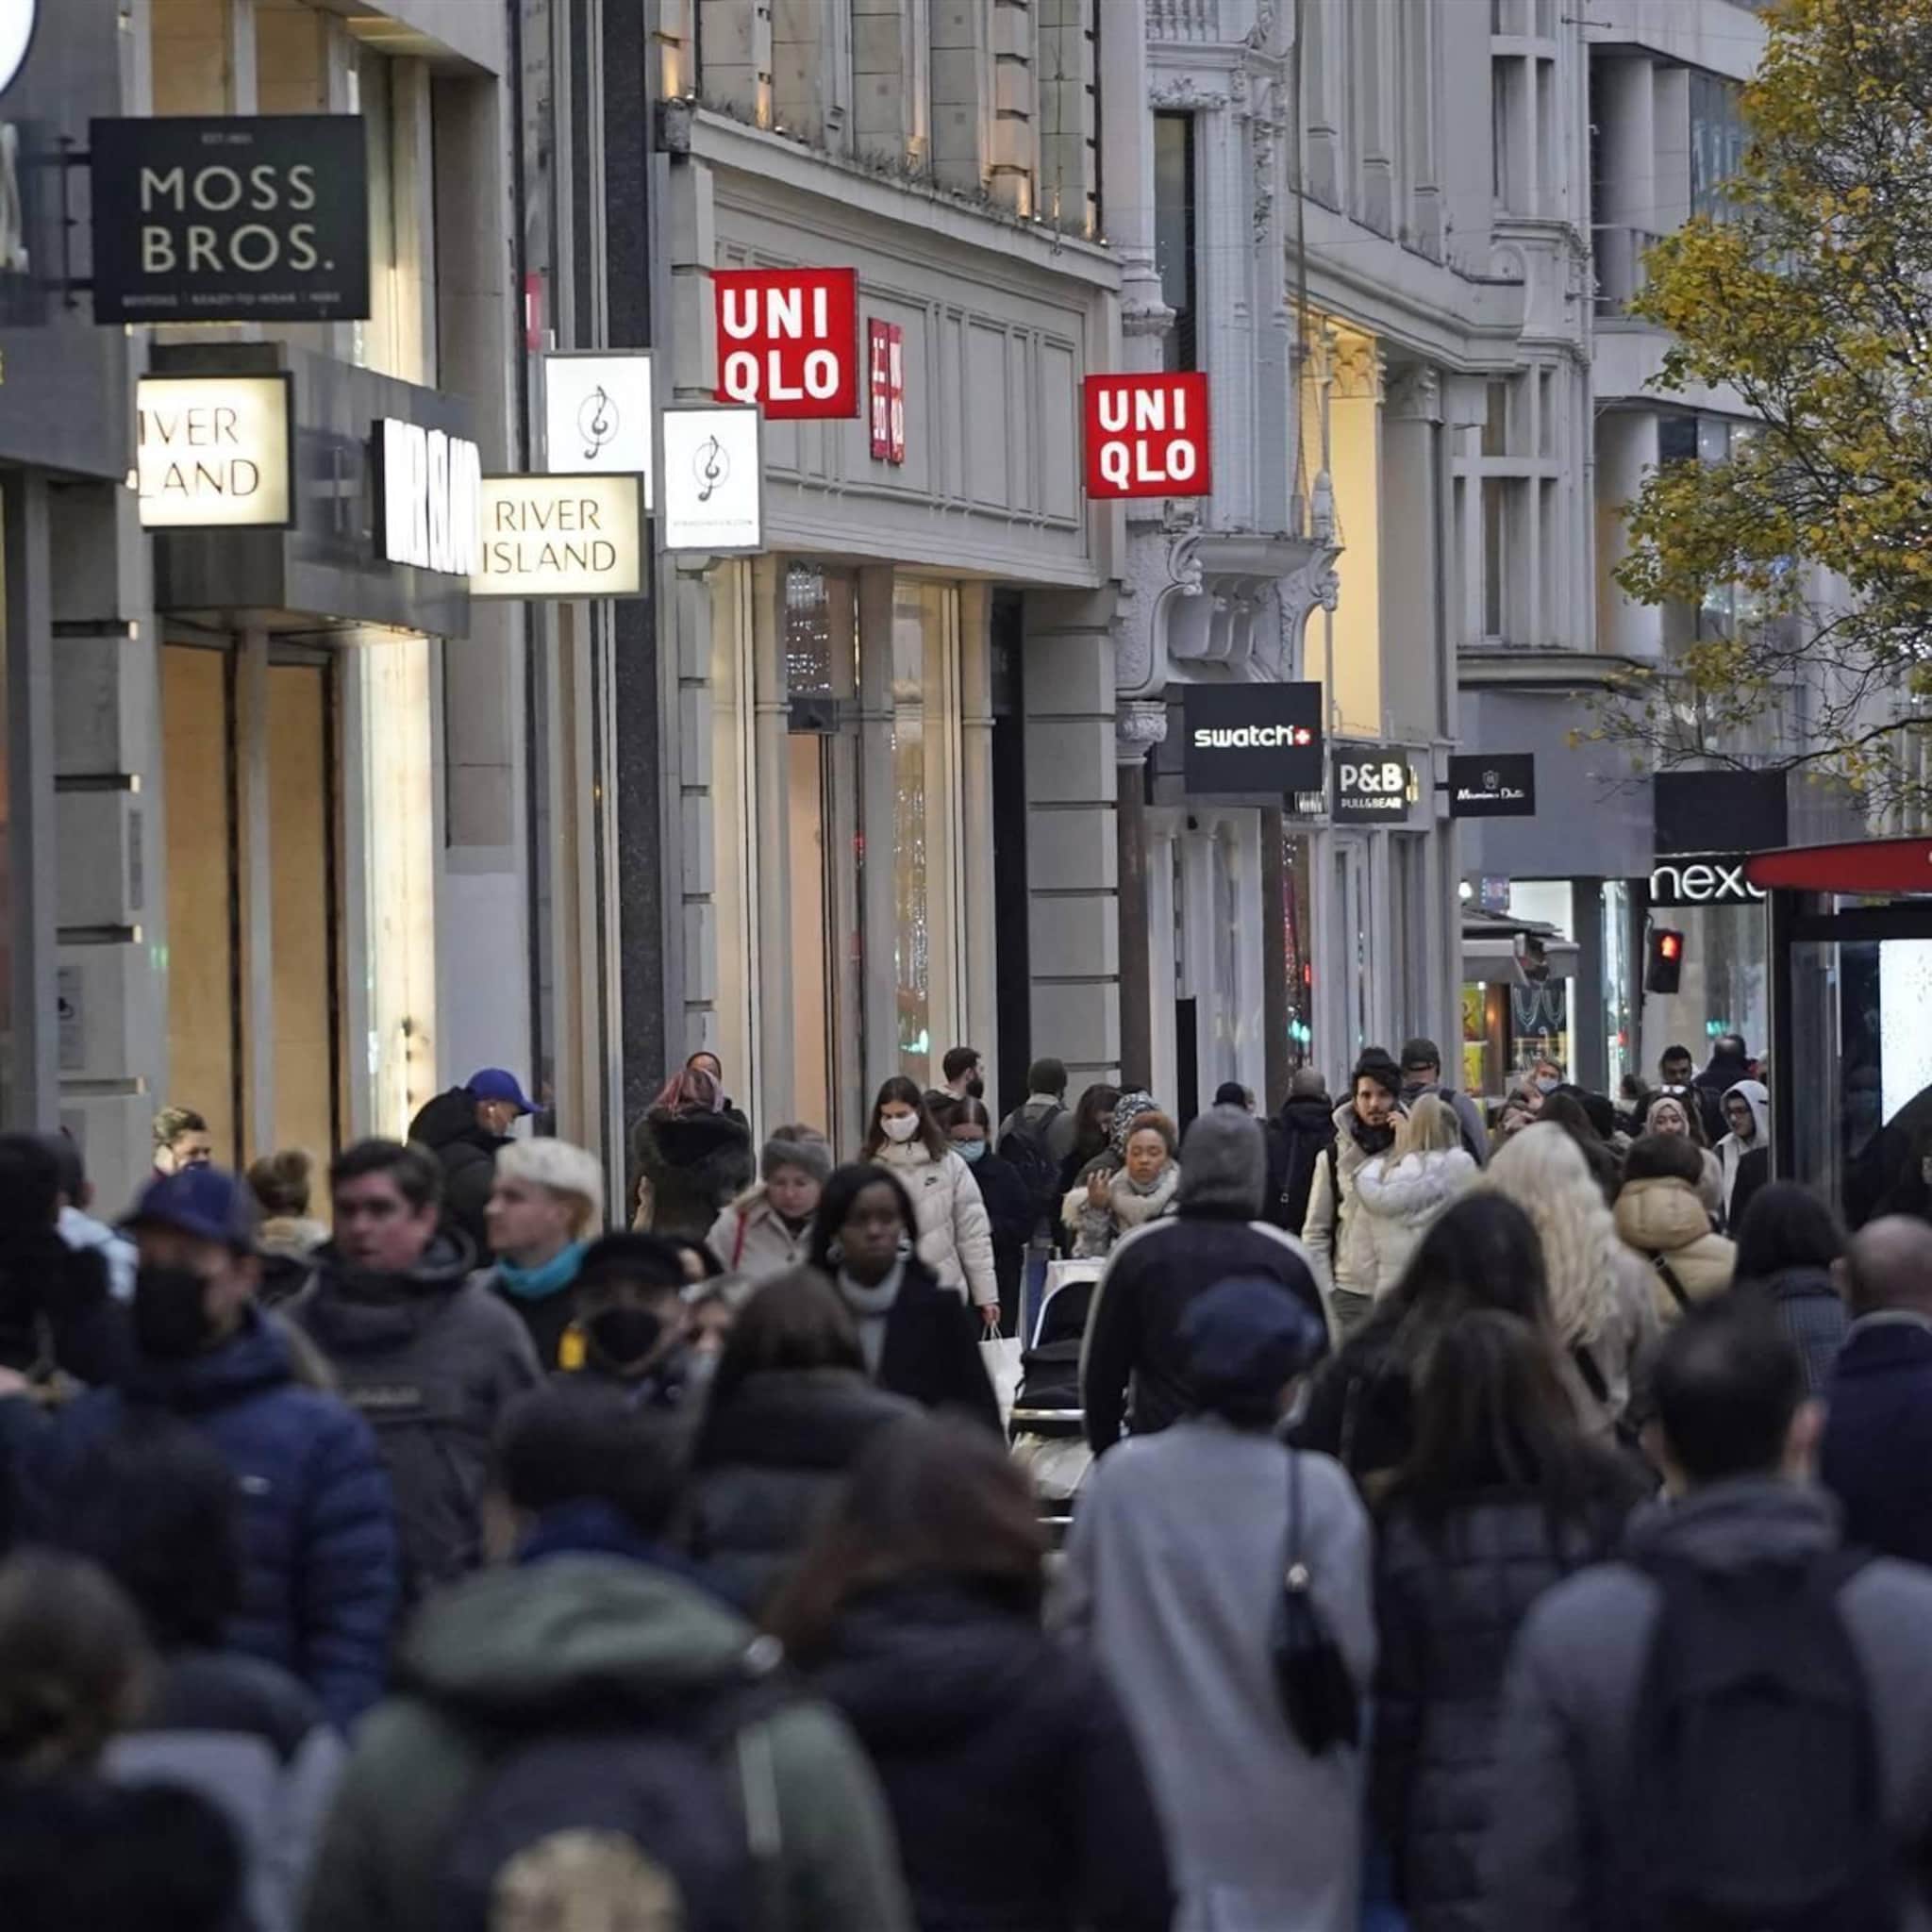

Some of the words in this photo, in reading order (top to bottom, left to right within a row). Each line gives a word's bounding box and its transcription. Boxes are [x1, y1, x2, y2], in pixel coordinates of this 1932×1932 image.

[141, 164, 316, 212] MOSS
[142, 224, 335, 274] BROS.
[723, 287, 828, 340] UNI
[724, 349, 841, 404] QLO
[1098, 388, 1186, 432] UNI
[1100, 439, 1196, 491] QLO
[496, 499, 601, 532] RIVER
[483, 541, 617, 575] ISLAND
[1193, 724, 1294, 748] swatch
[1340, 762, 1405, 793] P&B
